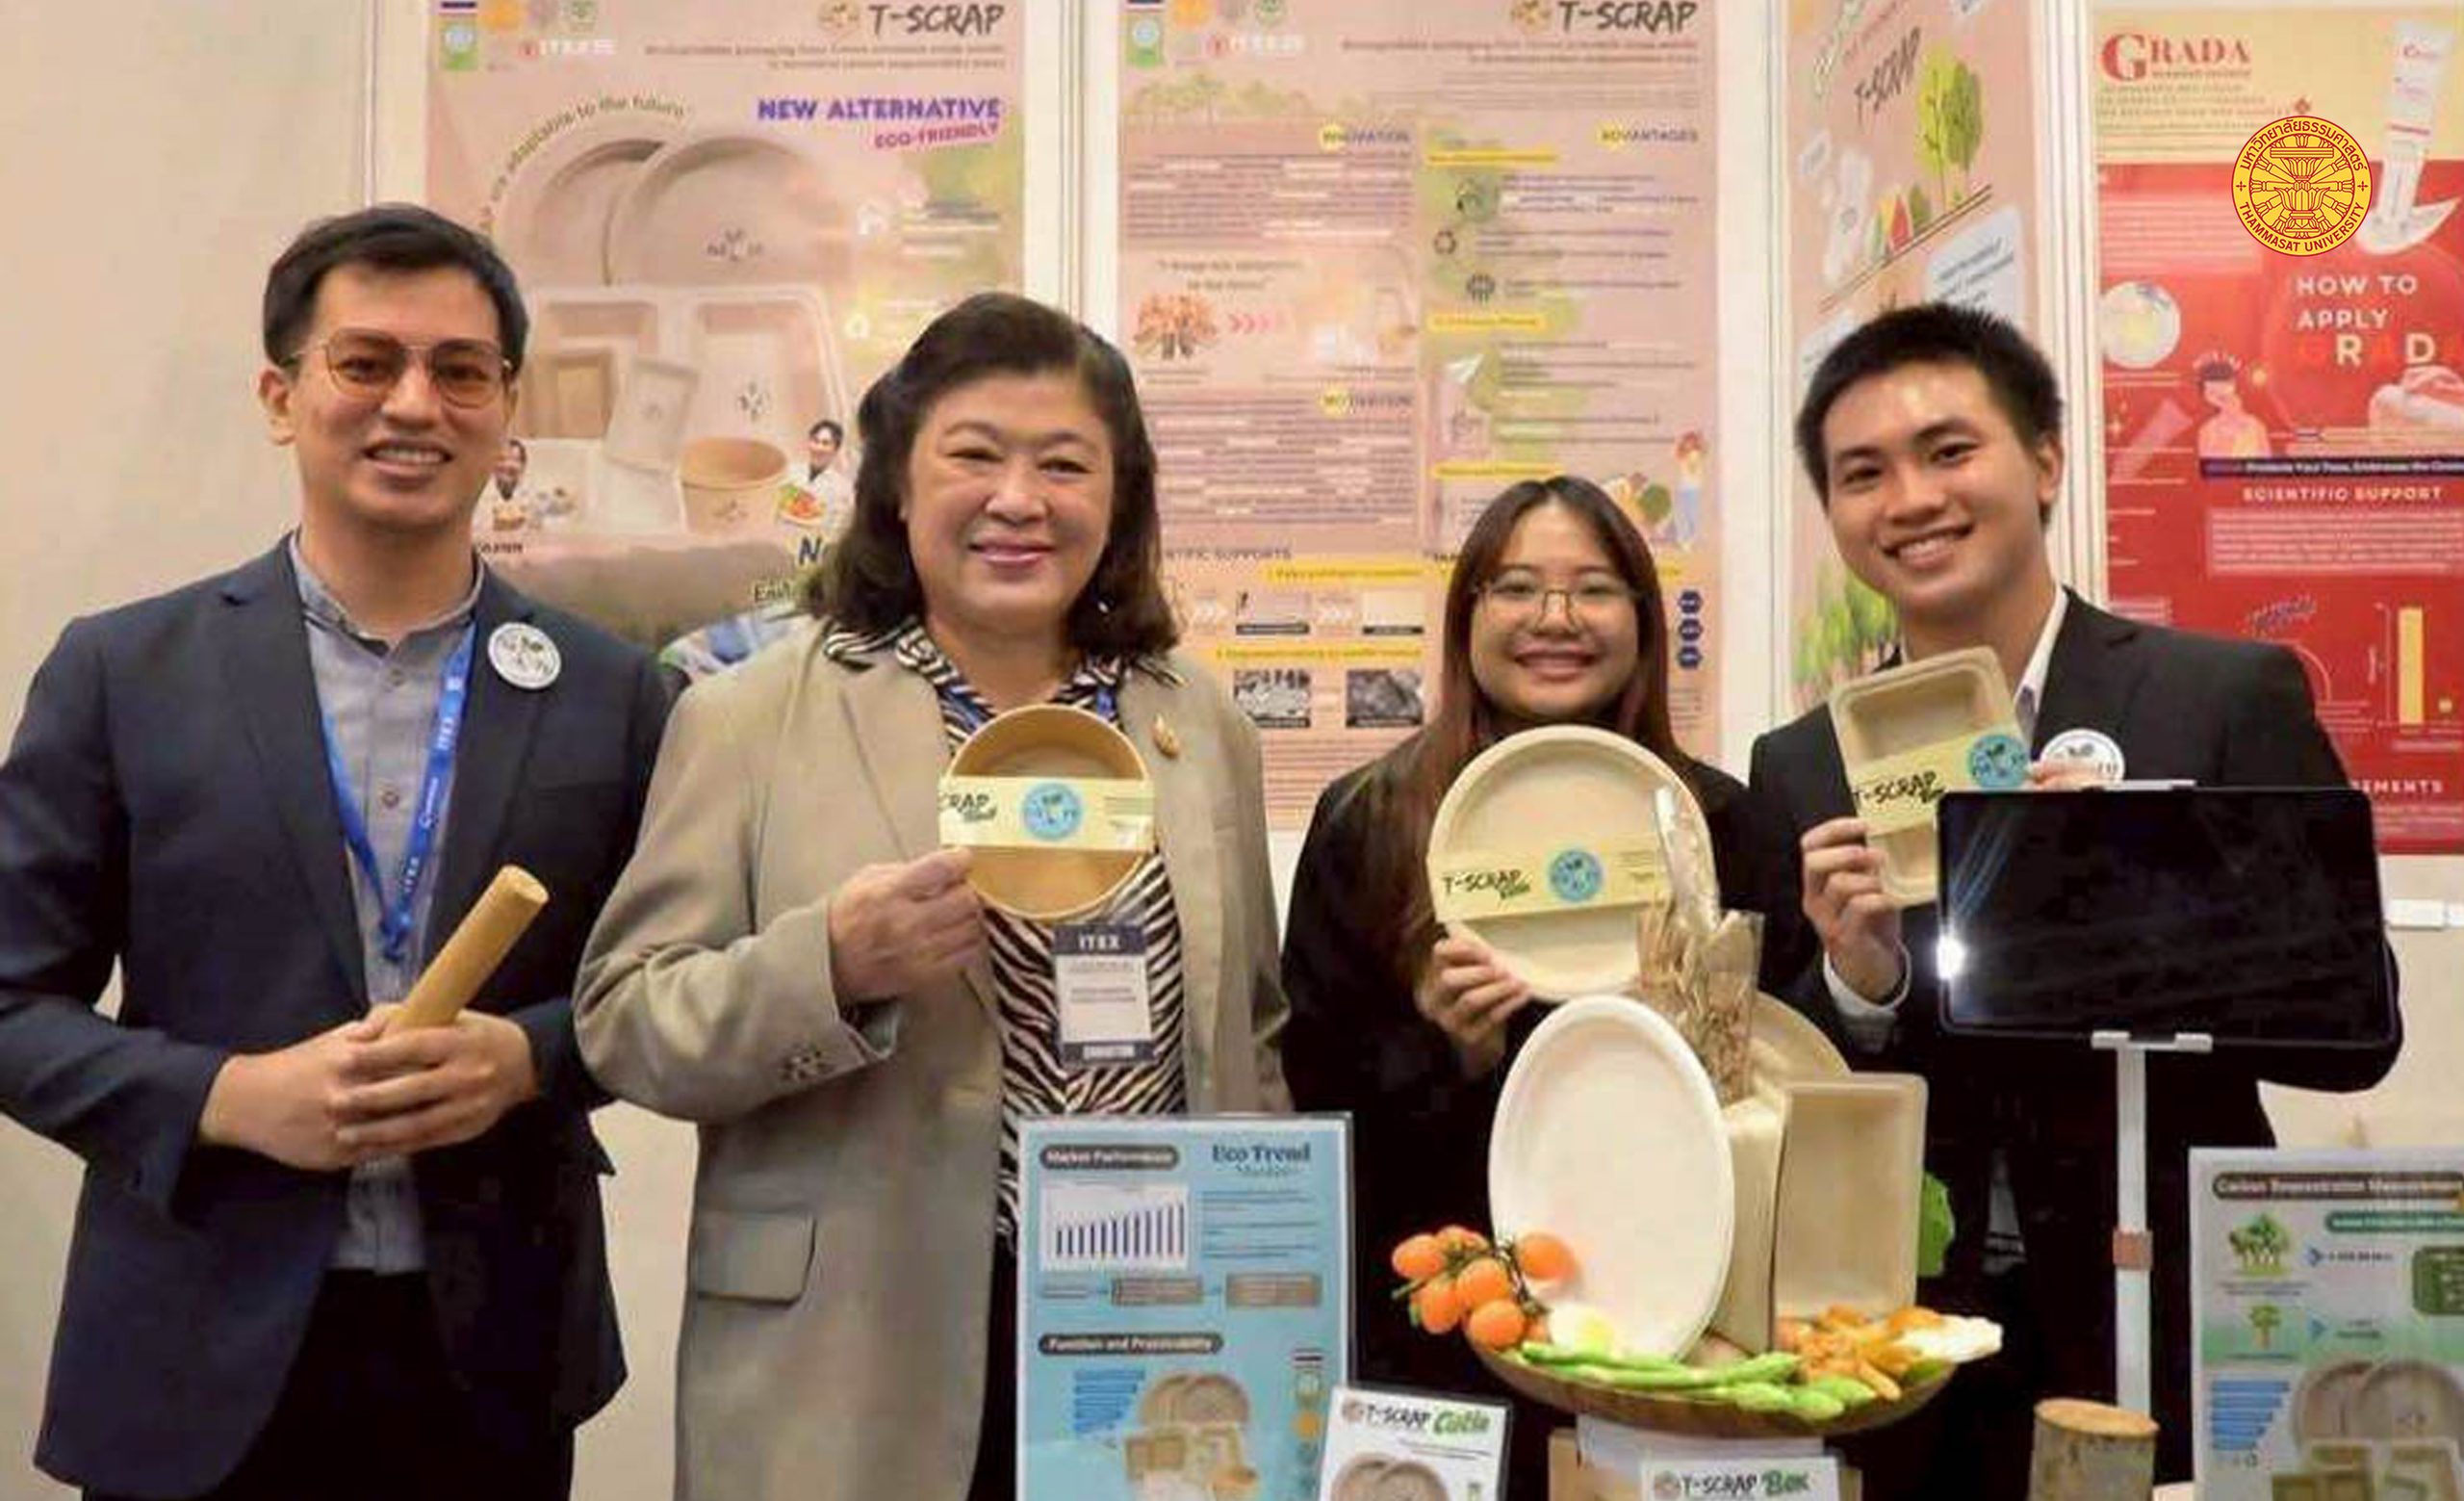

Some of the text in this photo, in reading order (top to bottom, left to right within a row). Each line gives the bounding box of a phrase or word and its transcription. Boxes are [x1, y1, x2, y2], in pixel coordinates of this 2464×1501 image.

[869, 4, 1005, 35] T-SCRAP
[1560, 2, 1698, 34] T-SCRAP
[2101, 33, 2251, 82] GRADA
[758, 98, 1001, 119] NEW ALTERNATIVE
[875, 122, 999, 149] ECO-FRIENDLY
[2297, 275, 2418, 297] HOW TO
[2297, 309, 2388, 328] APPLY
[2244, 486, 2442, 503] SCIENTIFIC SUPPORT
[1443, 868, 1522, 895] T-SCRAP
[1212, 1142, 1311, 1163] Eco Trend
[1366, 1404, 1433, 1429] T-SCRAP
